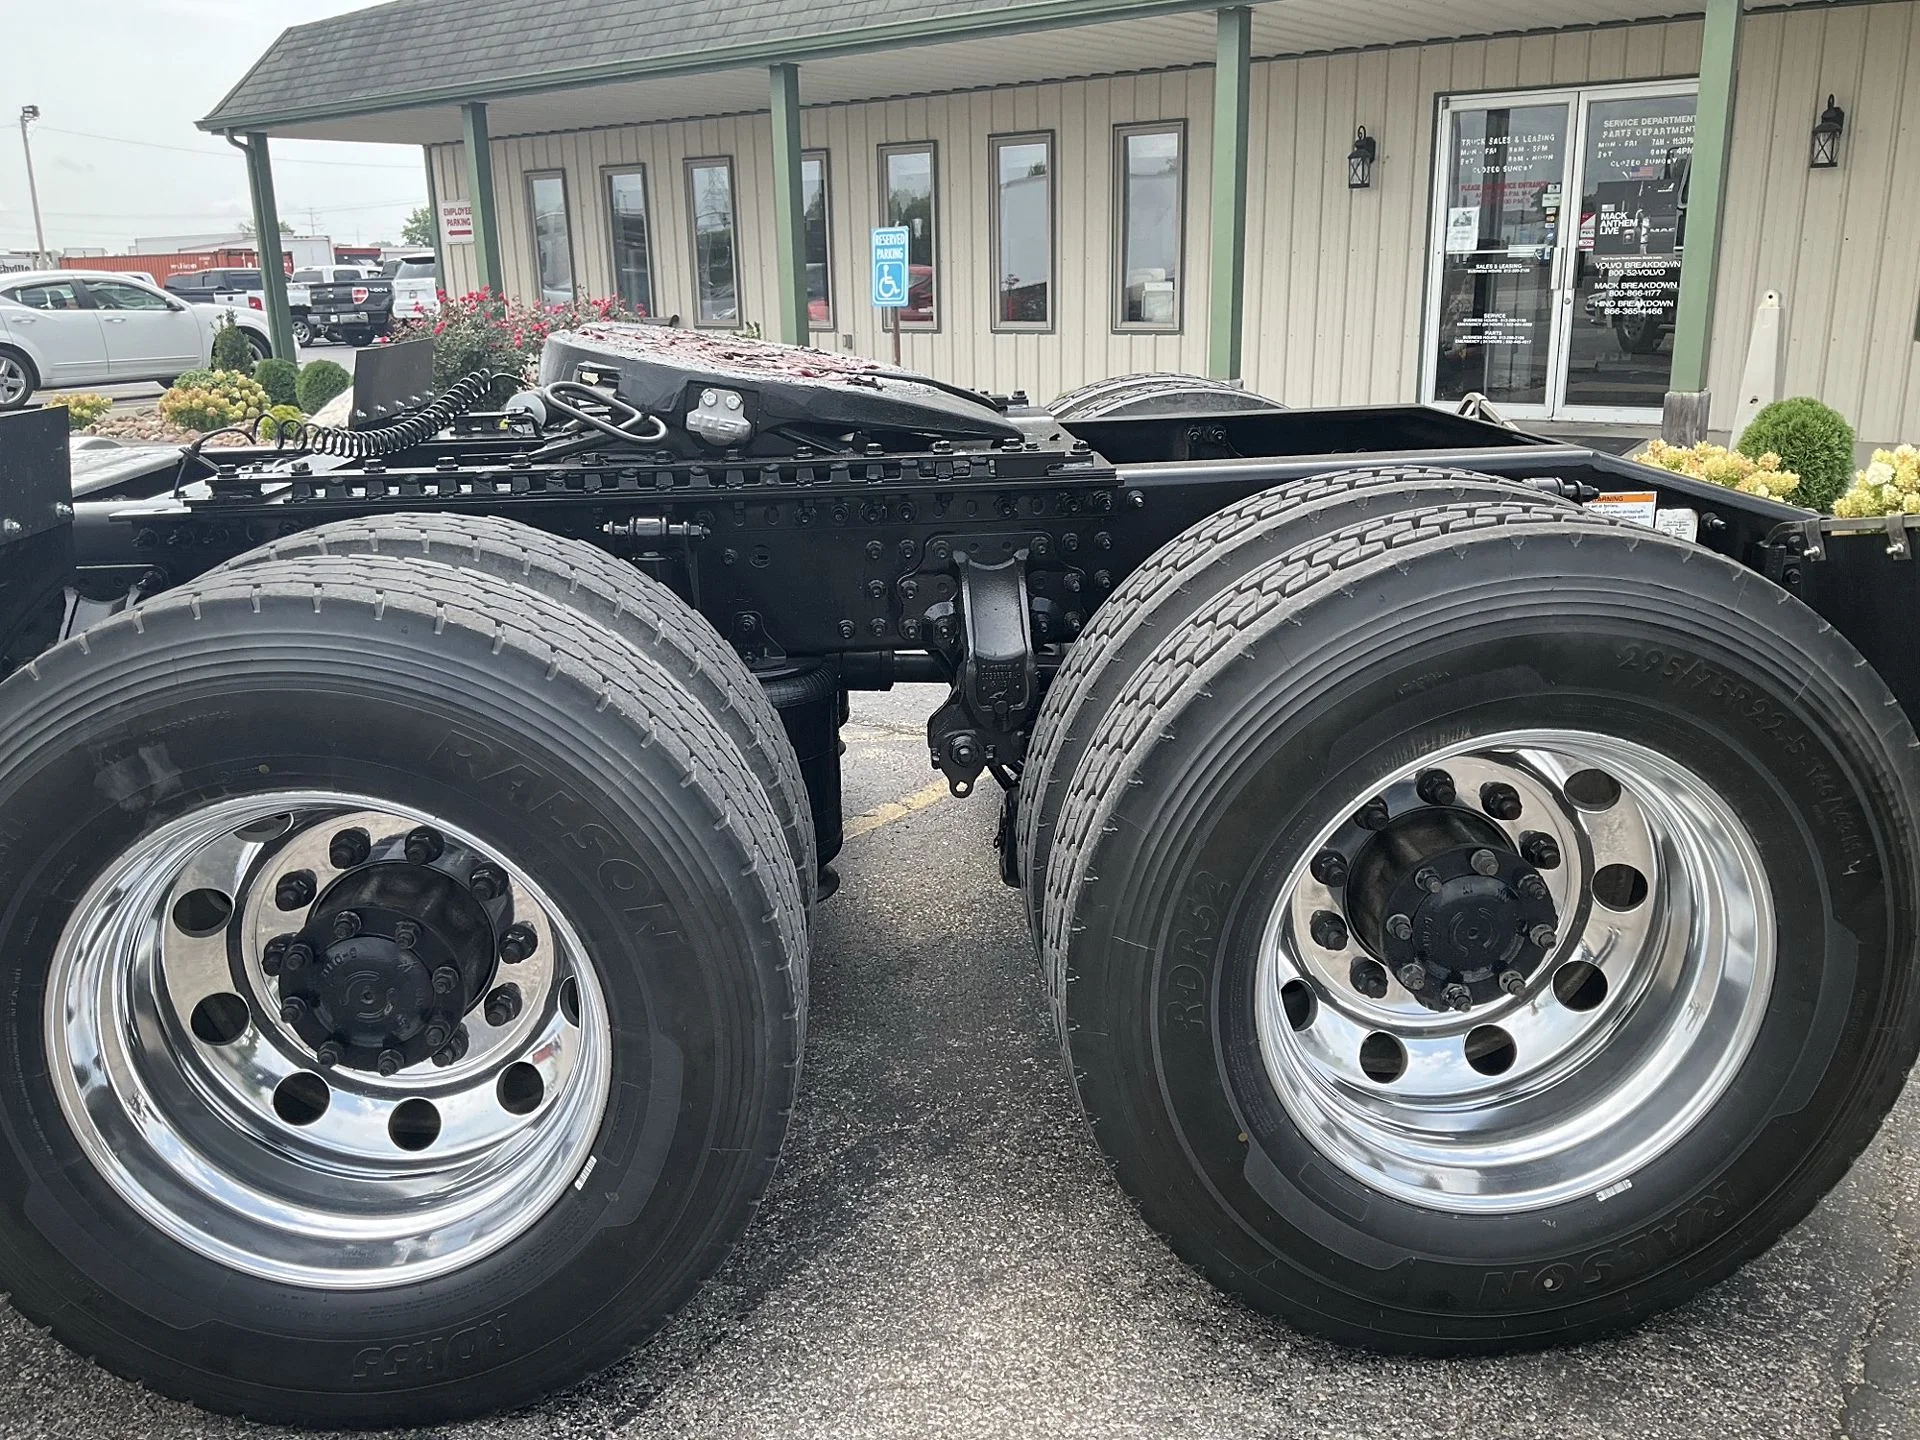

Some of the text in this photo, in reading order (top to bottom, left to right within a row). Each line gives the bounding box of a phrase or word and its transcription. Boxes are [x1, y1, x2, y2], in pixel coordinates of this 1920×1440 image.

[1603, 118, 1639, 128] SERVICE
[1602, 129, 1632, 138] PARTS
[1461, 138, 1486, 146] TRUCK
[1488, 136, 1511, 145] SALES
[1523, 134, 1555, 143] LEASING
[1652, 138, 1665, 146] 7AM
[1610, 159, 1641, 167] CLOSED
[1472, 166, 1500, 174] CLOSED
[443, 207, 472, 216] EMPLOYEE
[1601, 211, 1629, 220] MACK
[446, 218, 471, 227] PARKING
[1600, 219, 1638, 227] ANTHEM
[1600, 227, 1620, 235] LIVE
[875, 233, 905, 246] RESERVED
[876, 247, 904, 260] PARKING
[1595, 261, 1681, 269] VOLVO BREAKDOWN
[426, 729, 688, 945] RALSON
